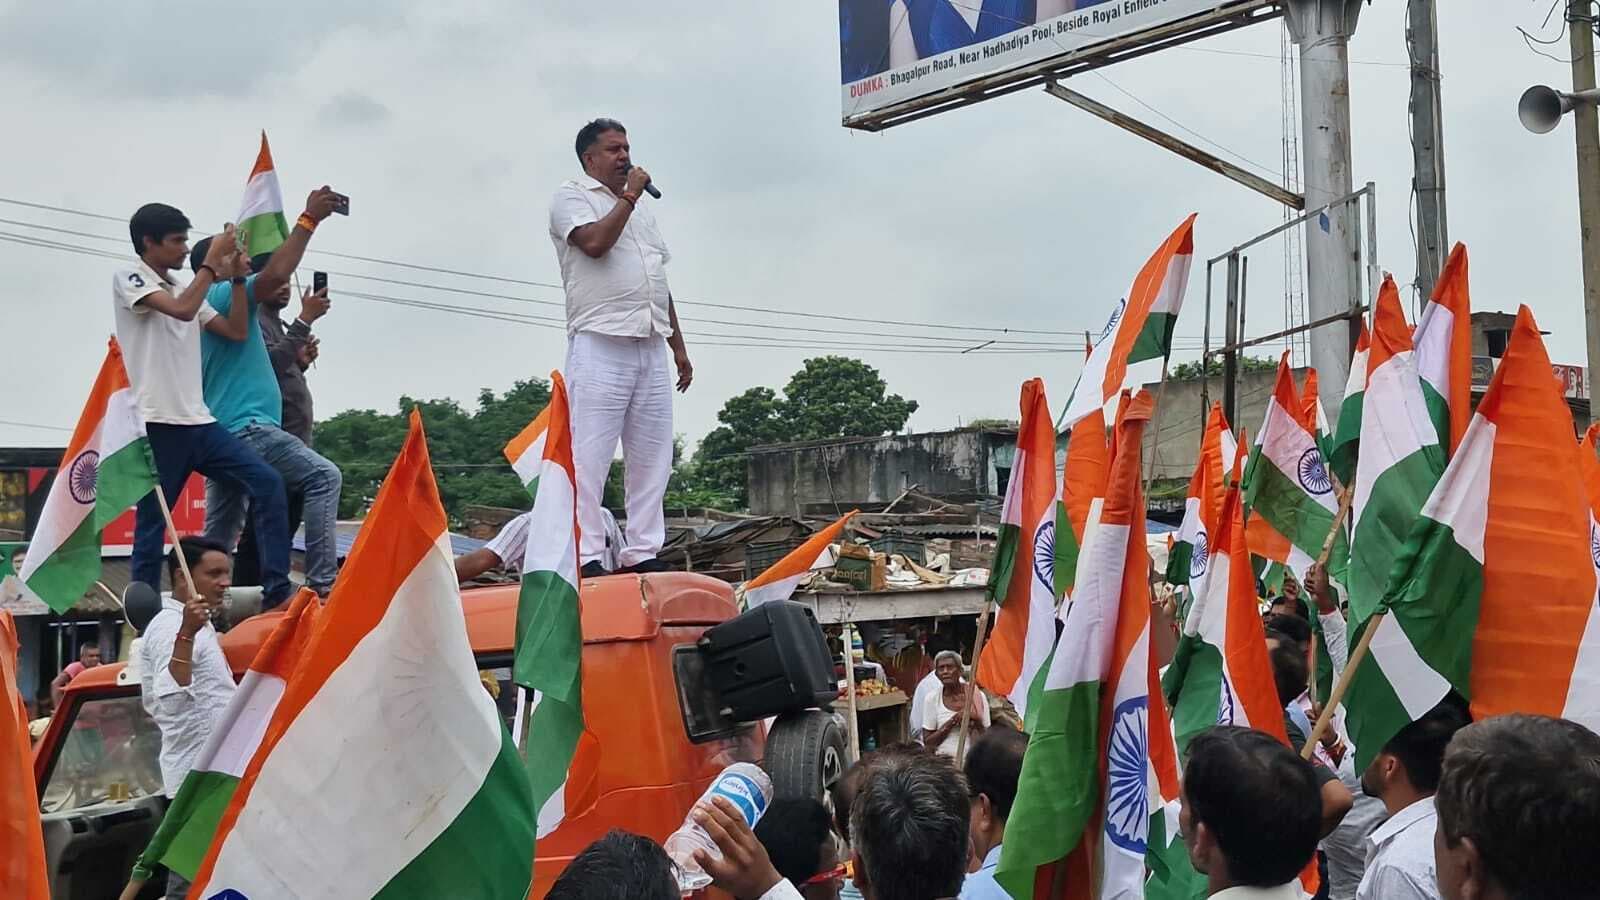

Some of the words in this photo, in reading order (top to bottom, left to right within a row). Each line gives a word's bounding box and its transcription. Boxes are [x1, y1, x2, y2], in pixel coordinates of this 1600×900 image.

[850, 77, 883, 98] DUMKA
[890, 64, 931, 86] Bhagalpur
[933, 55, 957, 73] Road,
[959, 50, 980, 64] Near
[983, 34, 1029, 58] Hadhadiya
[1032, 23, 1055, 42] Pool,
[1056, 14, 1089, 34] Beside
[1092, 4, 1121, 24] Royal
[128, 273, 145, 288] 3
